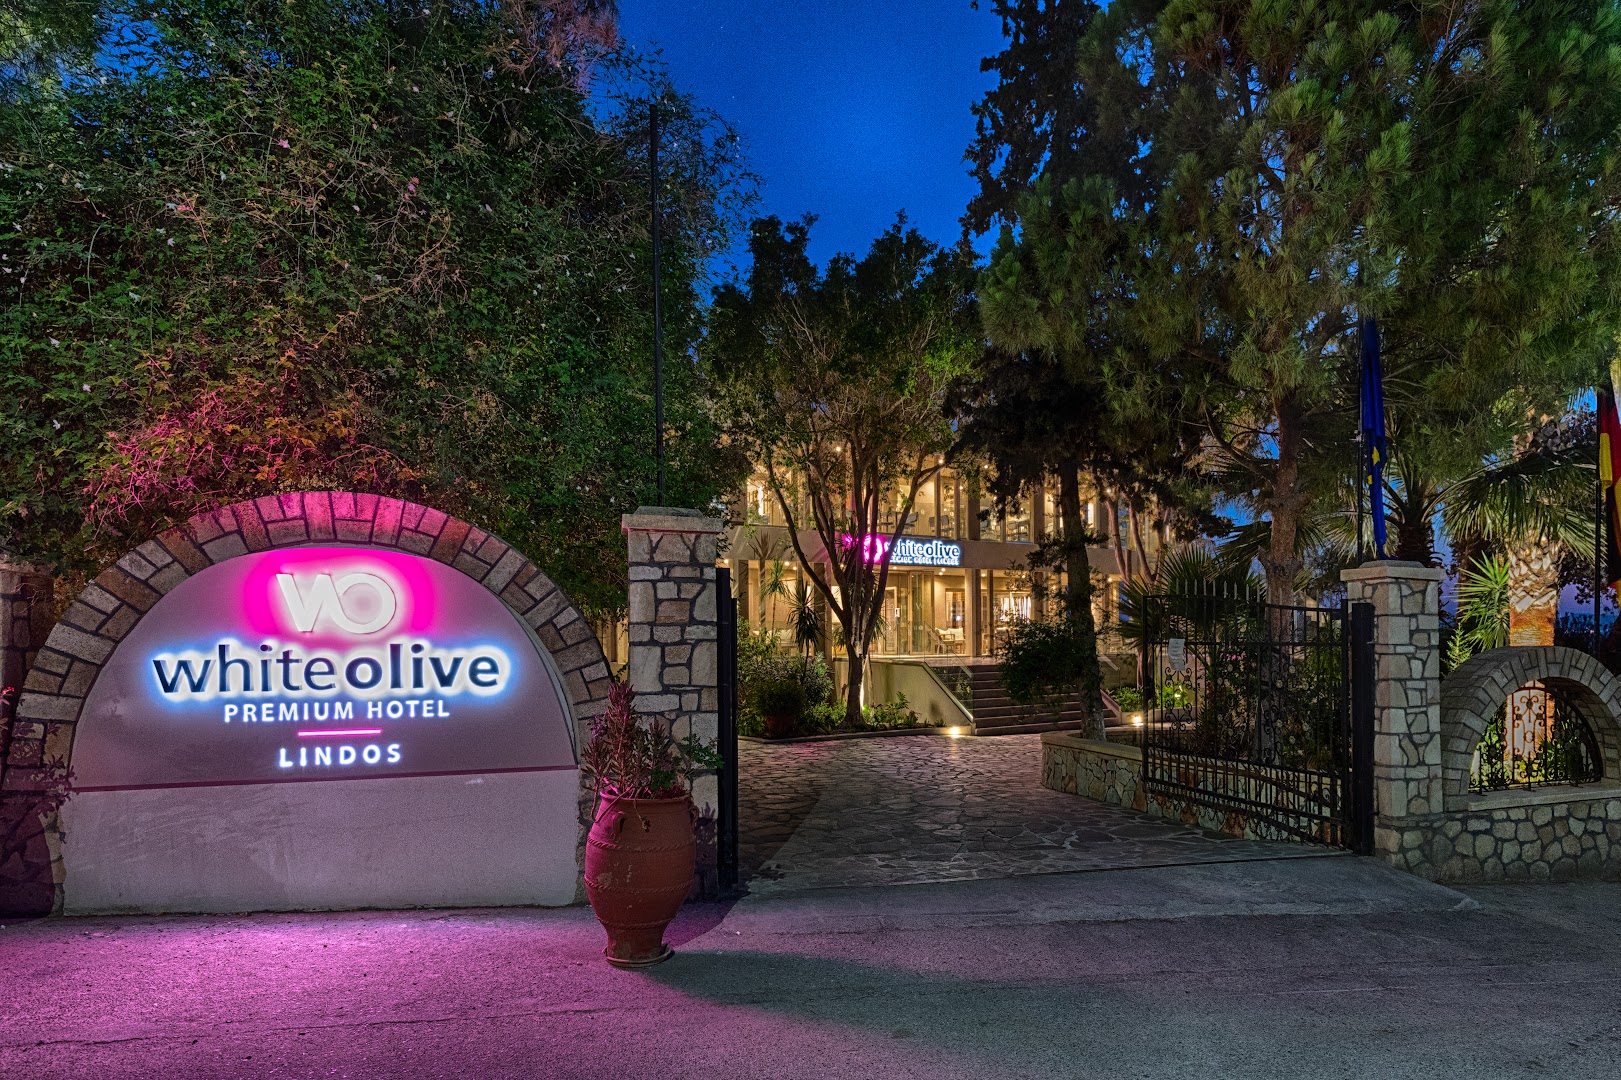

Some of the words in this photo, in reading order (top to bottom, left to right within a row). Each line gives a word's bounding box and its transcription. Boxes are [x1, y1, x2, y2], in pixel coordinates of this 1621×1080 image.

[152, 643, 500, 694] whiteolive
[224, 701, 354, 723] PREMIUM
[367, 699, 450, 719] HOTEL
[279, 743, 401, 768] LINDOS
